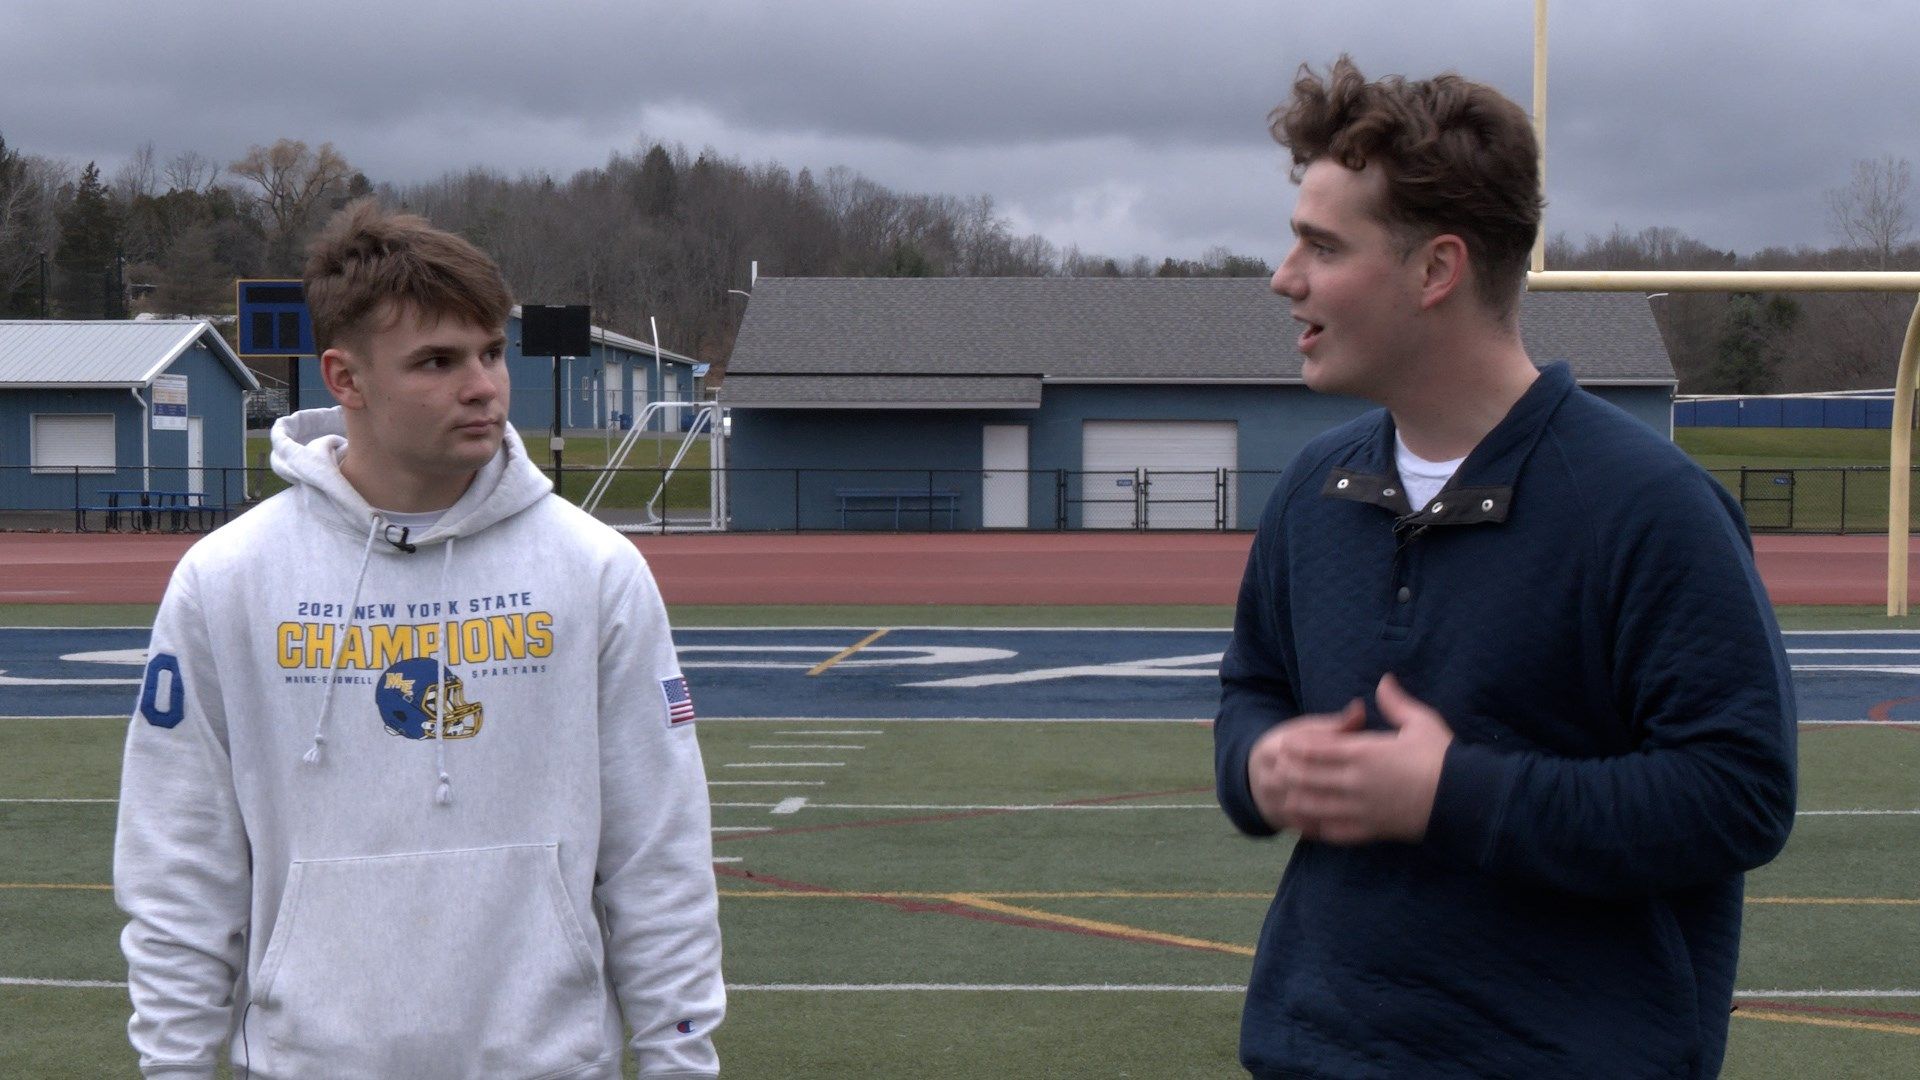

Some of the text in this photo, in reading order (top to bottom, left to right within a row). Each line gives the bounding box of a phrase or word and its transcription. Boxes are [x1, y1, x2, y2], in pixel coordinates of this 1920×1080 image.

[298, 601, 344, 618] 2021
[354, 602, 396, 619] NEW
[469, 591, 532, 613] STATE
[276, 610, 554, 670] CHAMPIONS
[285, 664, 548, 685] MAINE-EDWELL SPARTANS
